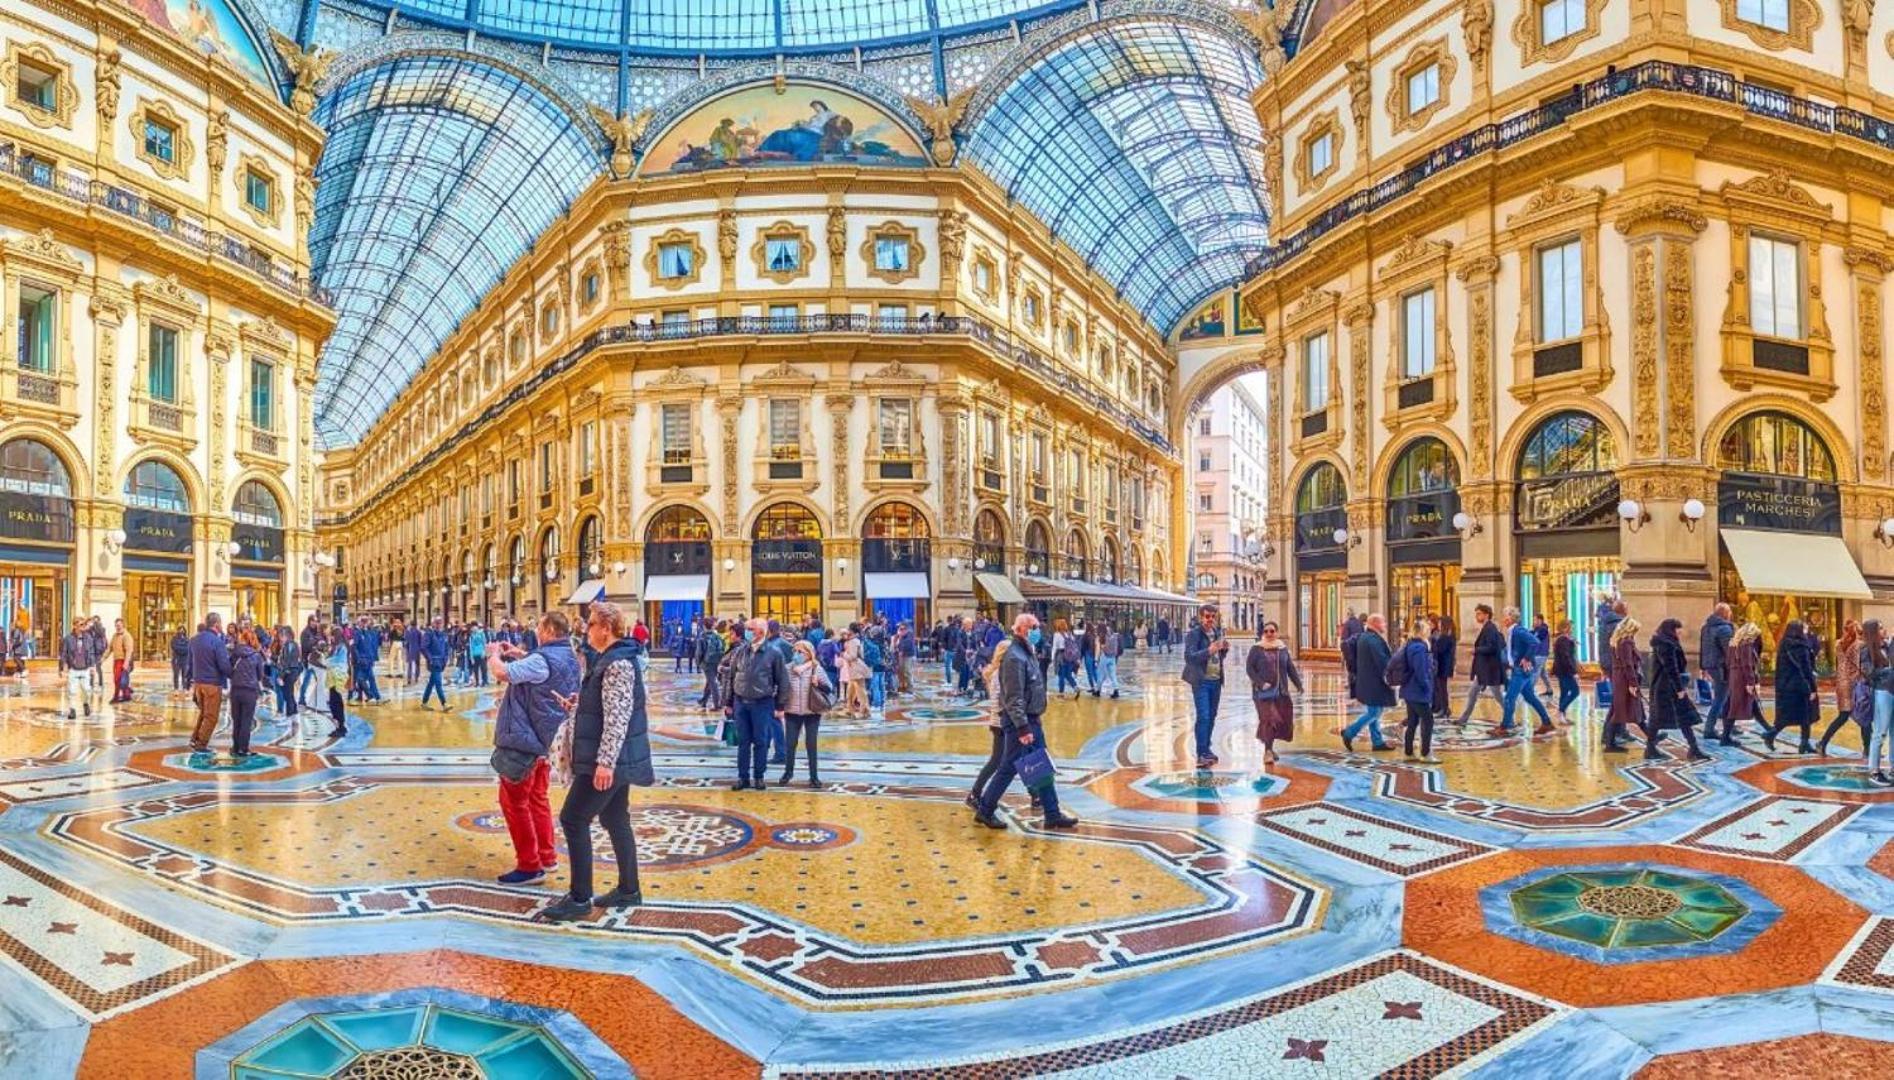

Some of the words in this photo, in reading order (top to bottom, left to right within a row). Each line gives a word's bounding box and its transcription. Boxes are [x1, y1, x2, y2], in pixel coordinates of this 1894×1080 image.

[1542, 496, 1591, 509] PRADA
[1736, 490, 1822, 507] PASTICCERIA
[8, 510, 51, 523] PRADA
[1745, 503, 1816, 518] MARCHESI
[1406, 512, 1443, 524] PRADA
[140, 526, 176, 538] PRADA
